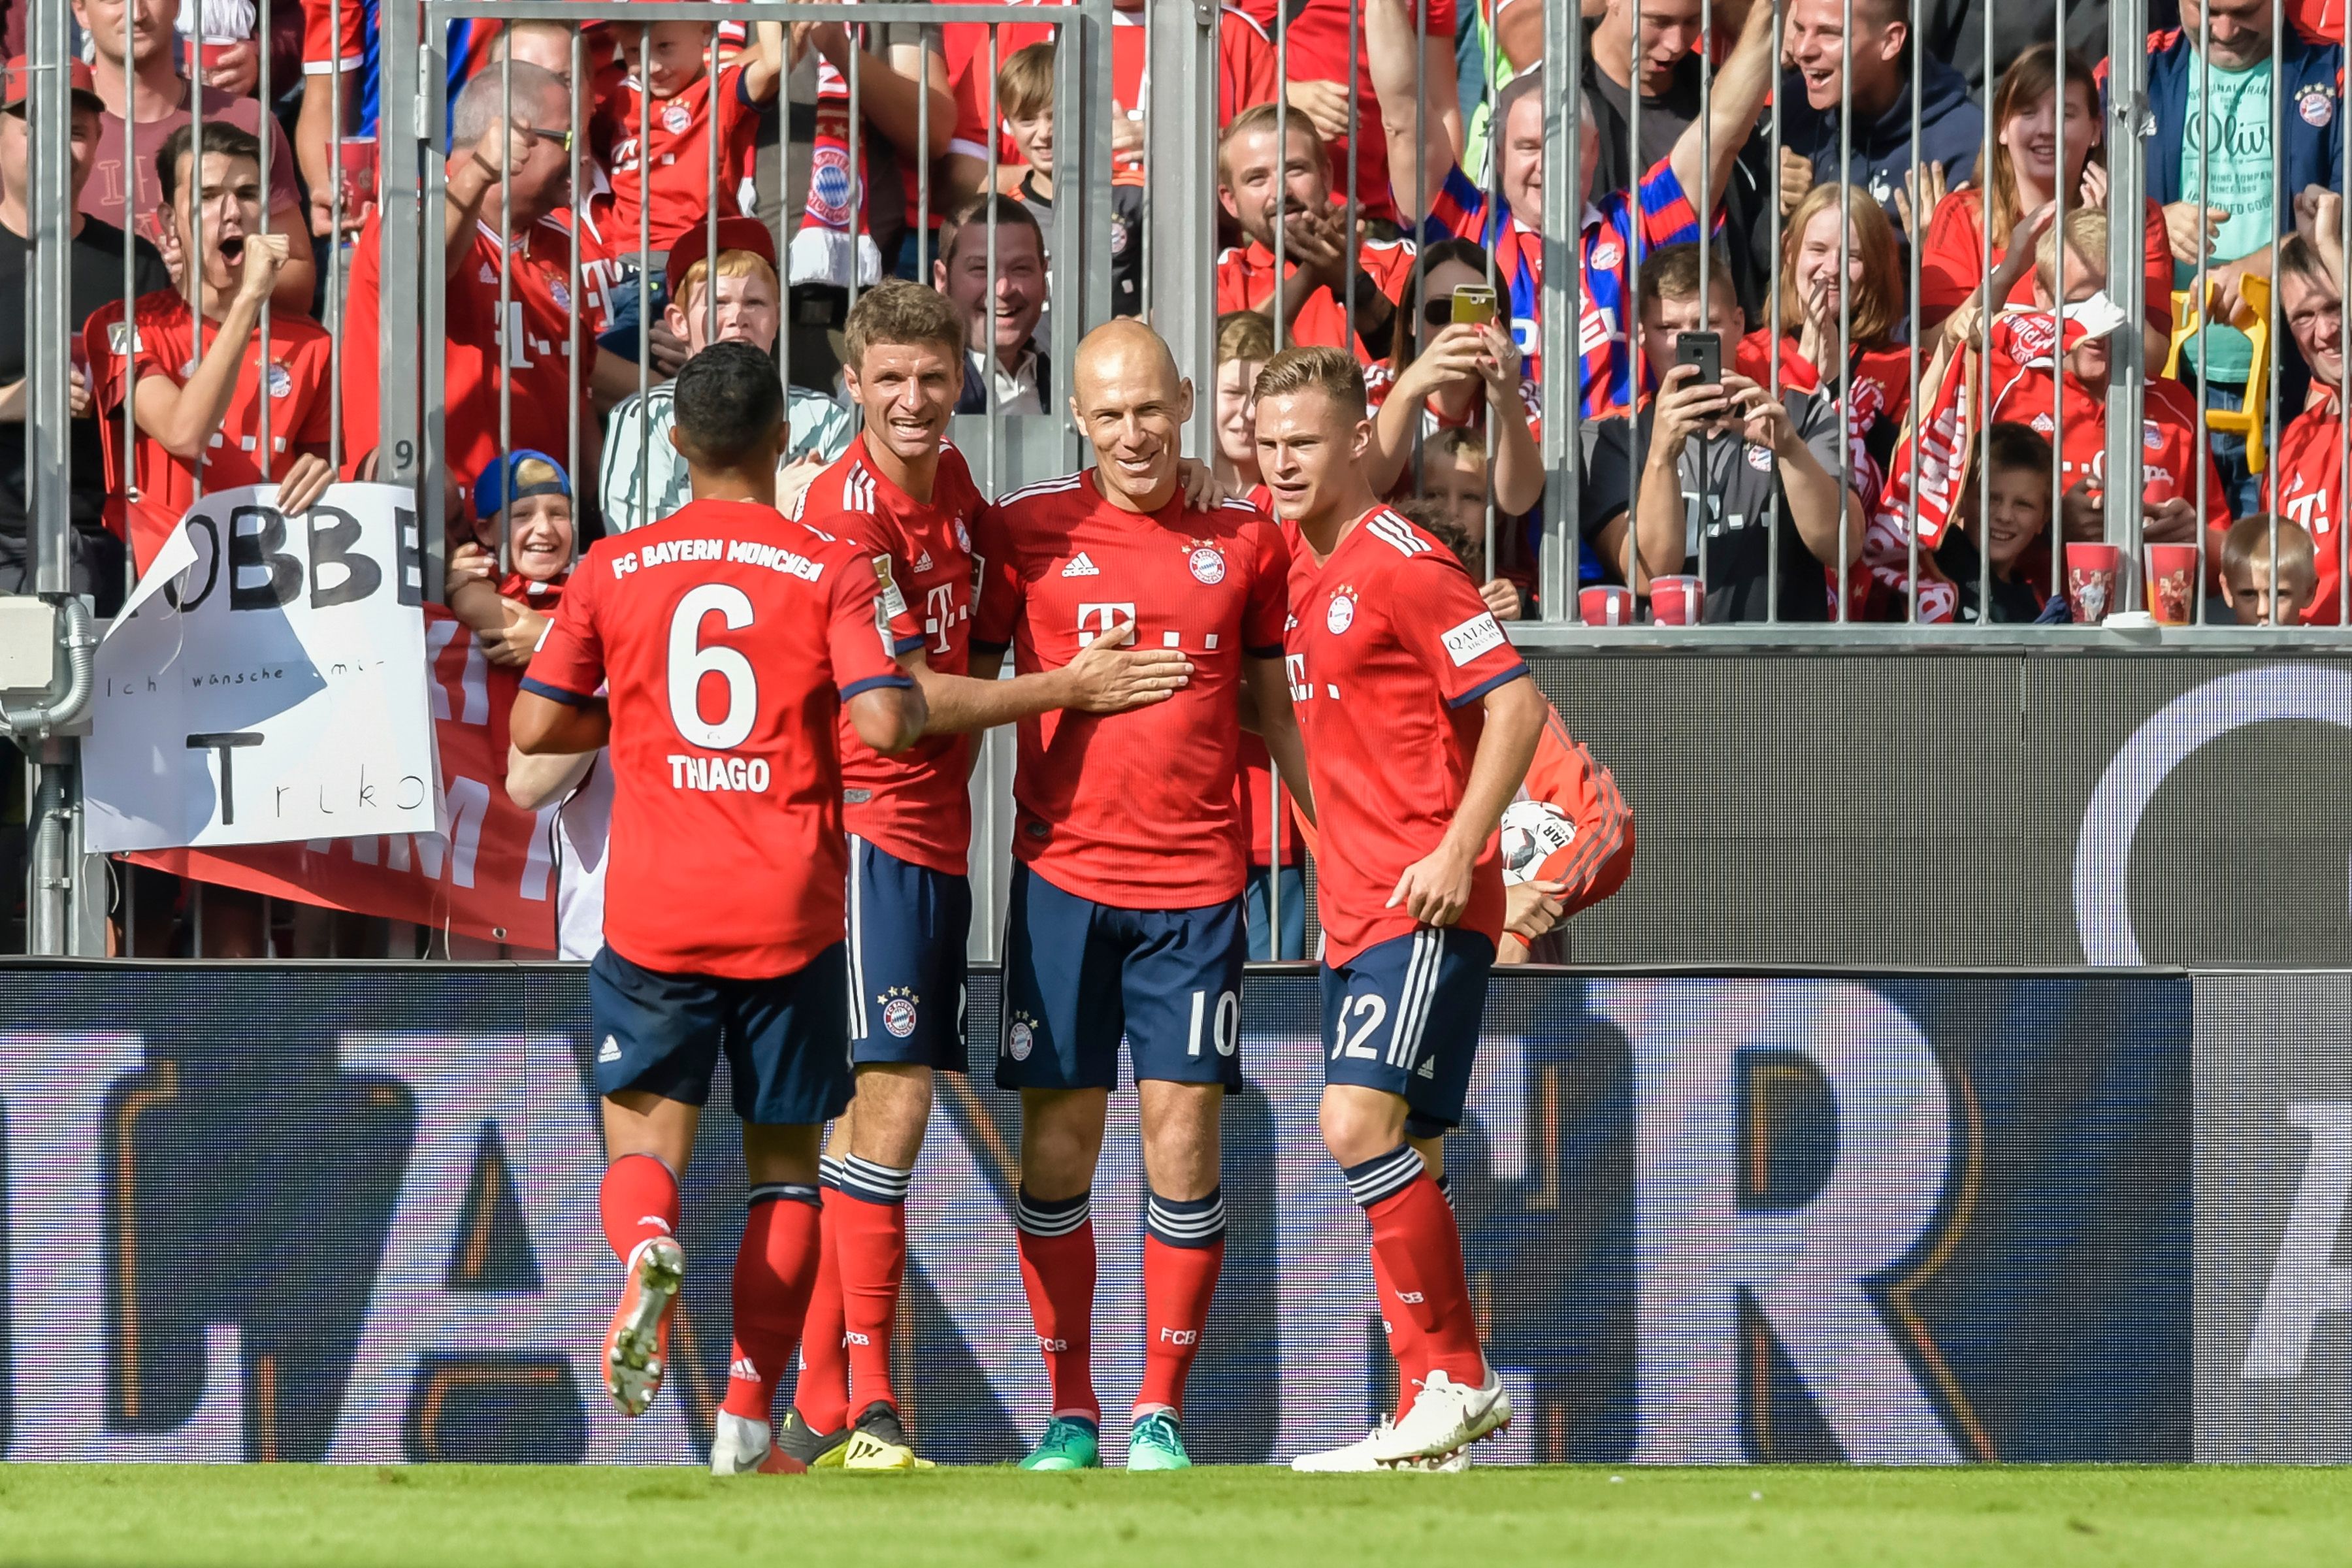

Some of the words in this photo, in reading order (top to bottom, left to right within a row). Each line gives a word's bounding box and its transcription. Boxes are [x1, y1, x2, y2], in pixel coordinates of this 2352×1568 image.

[395, 440, 413, 470] 9
[612, 552, 638, 580] FC
[642, 539, 723, 568] BAYERN
[1448, 619, 1495, 650] QATAR
[668, 583, 758, 750] 6
[107, 676, 157, 697] Ich
[667, 755, 770, 792] THIAGO
[1187, 990, 1237, 1056] 10
[846, 1330, 870, 1345] FCB
[1037, 1335, 1068, 1351] FCB
[1160, 1327, 1197, 1345] FCB
